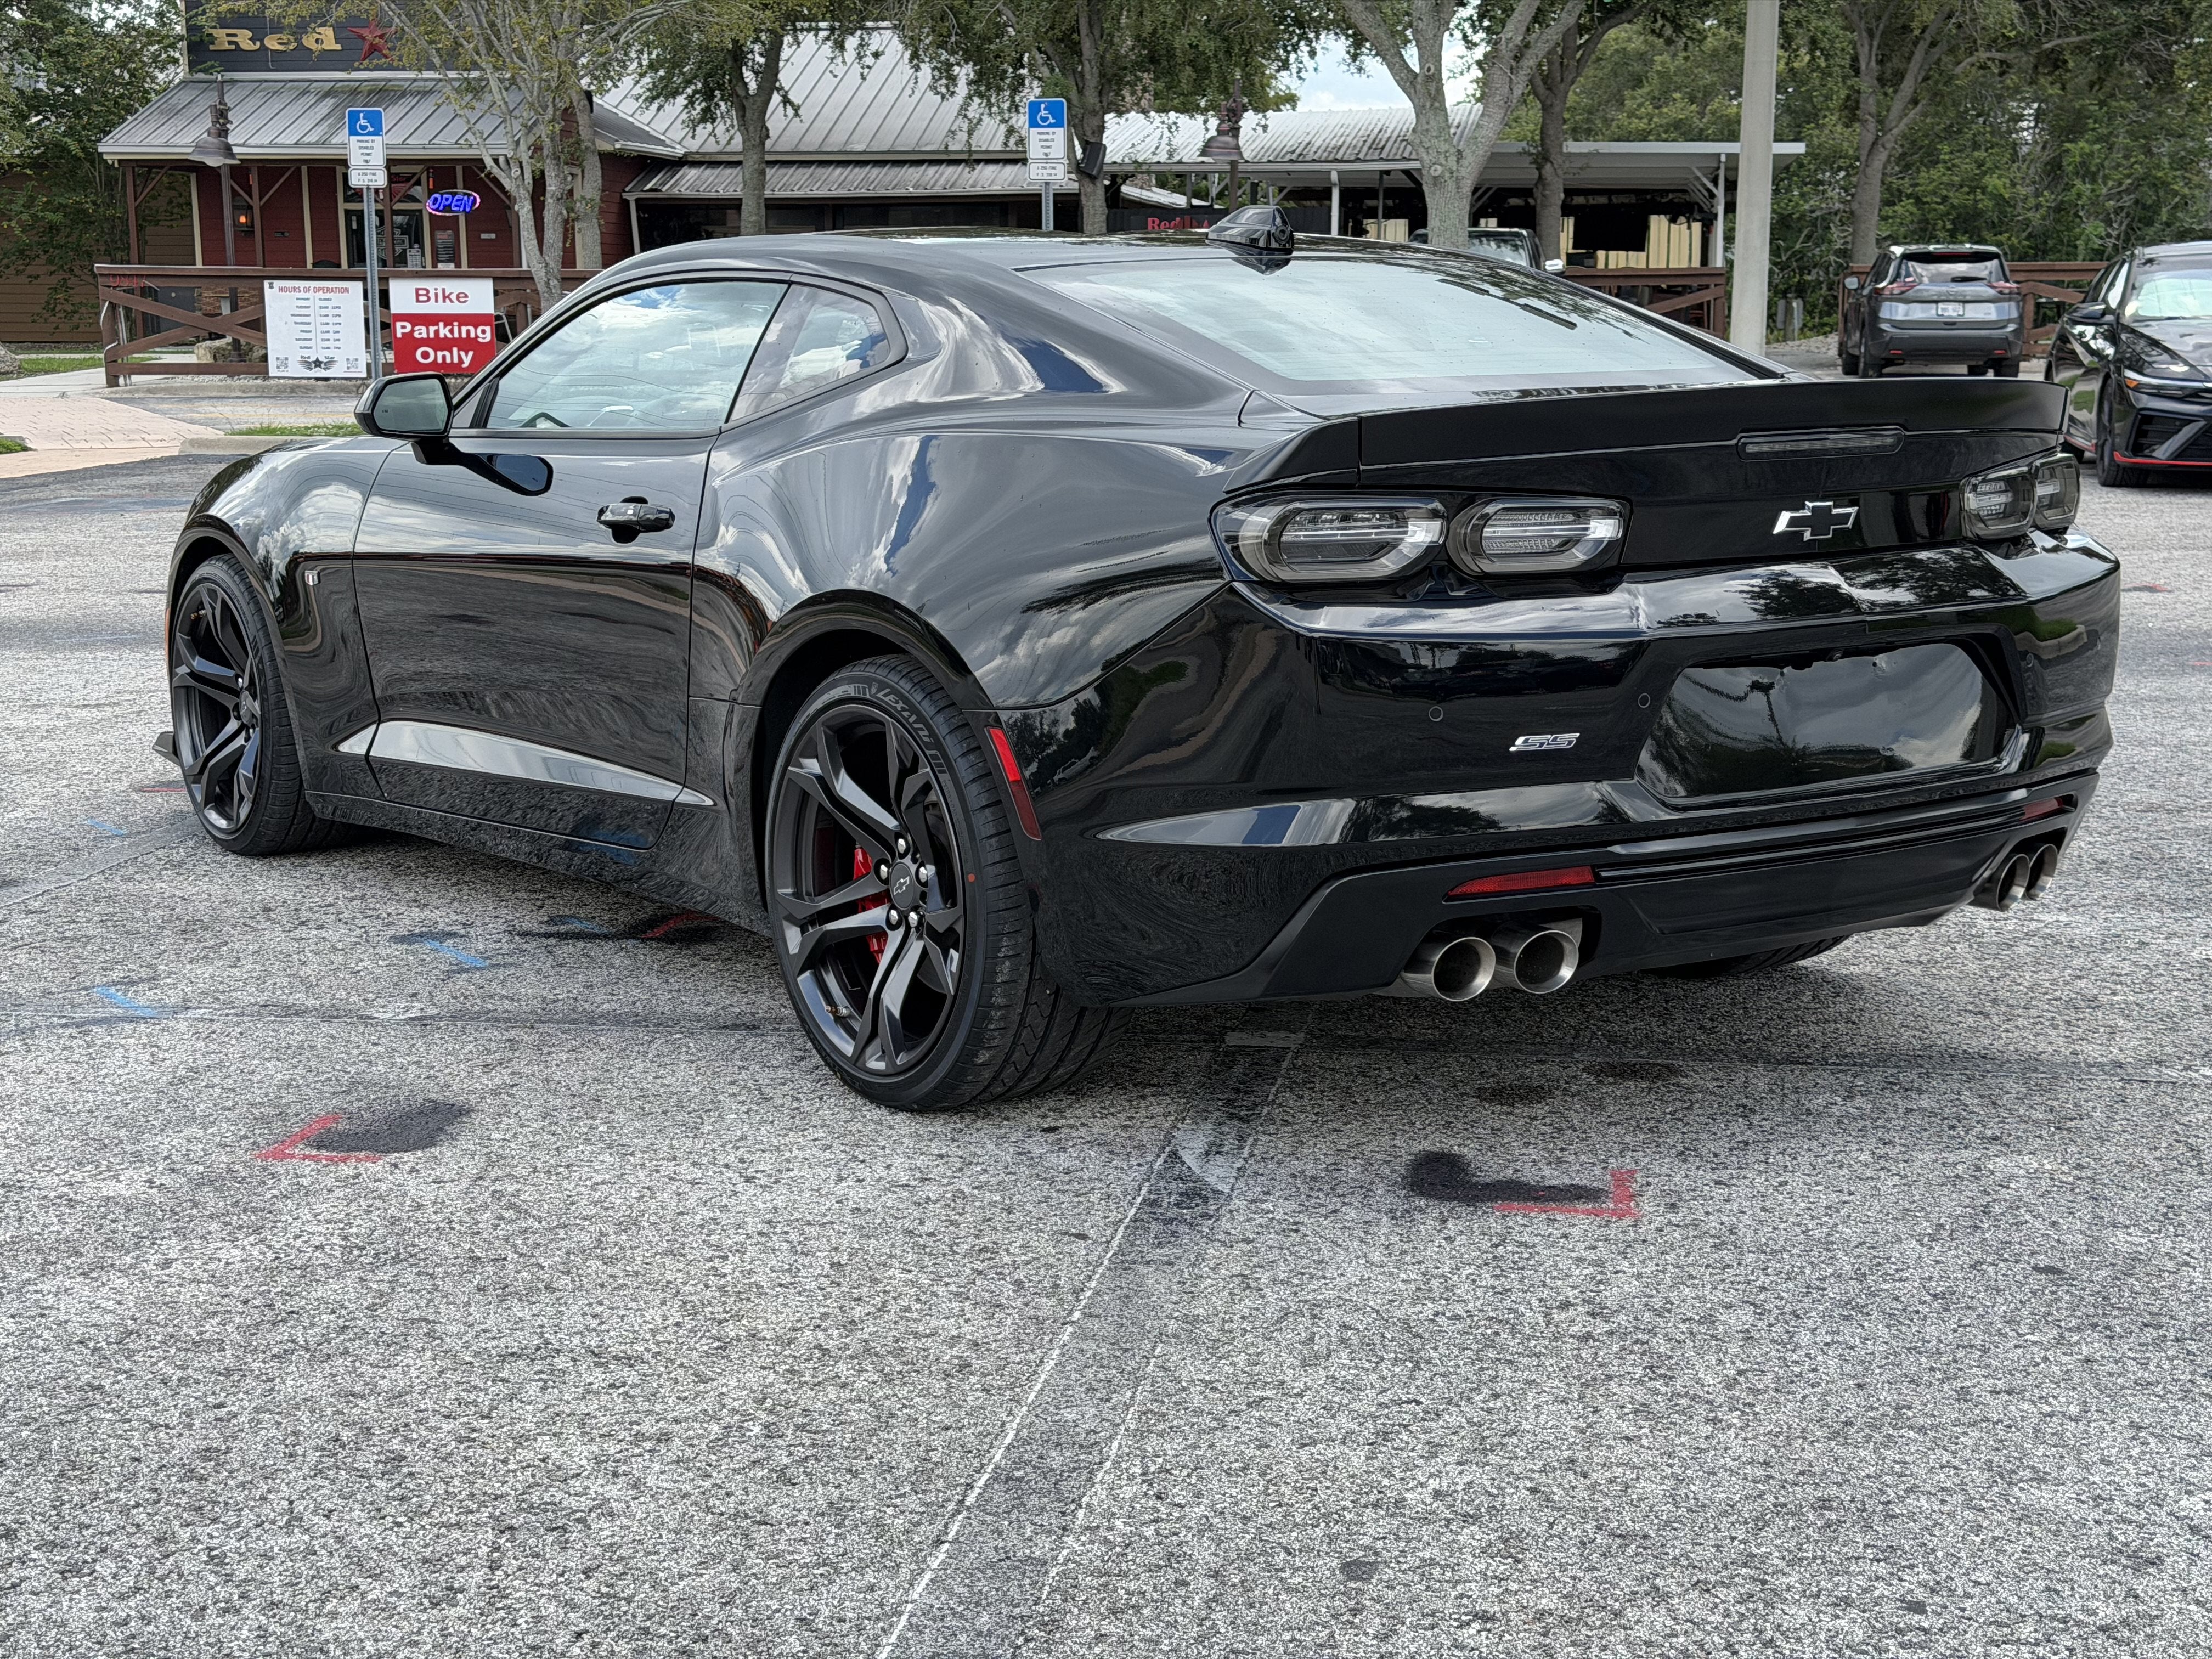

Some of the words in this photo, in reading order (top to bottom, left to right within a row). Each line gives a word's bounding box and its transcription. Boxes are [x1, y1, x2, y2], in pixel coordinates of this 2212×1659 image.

[207, 27, 342, 50] Red
[429, 193, 473, 212] OPEN
[415, 287, 469, 304] Bike
[396, 321, 491, 342] Parking
[416, 347, 474, 368] Only
[1509, 733, 1580, 752] SS
